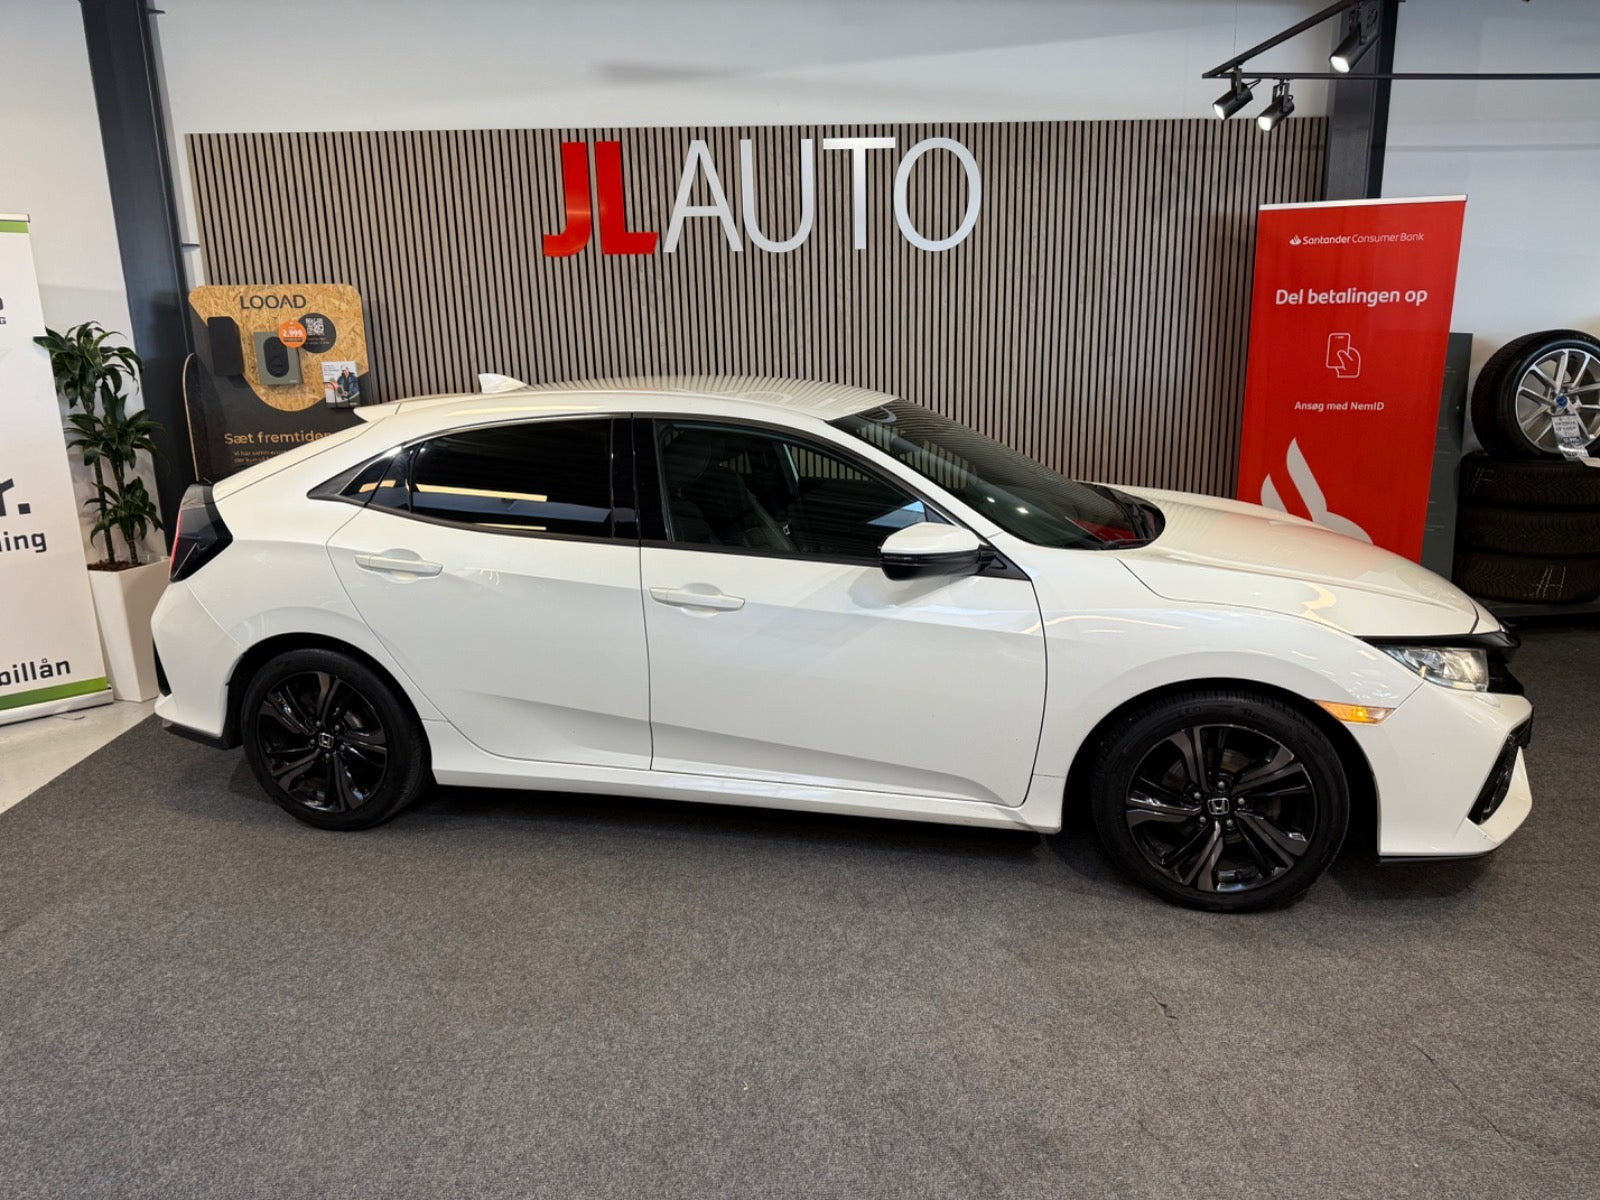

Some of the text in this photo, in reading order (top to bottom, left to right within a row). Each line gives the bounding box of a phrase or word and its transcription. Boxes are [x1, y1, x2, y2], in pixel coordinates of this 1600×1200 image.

[543, 136, 982, 258] JL AUTO
[1302, 232, 1424, 246] Santander Consumer Bank
[240, 294, 307, 310] LOOAD
[1275, 287, 1428, 308] Del betalingen op
[1294, 401, 1385, 413] Ansøg med NemID
[224, 432, 255, 445] Sæt
[0, 531, 47, 554] ing
